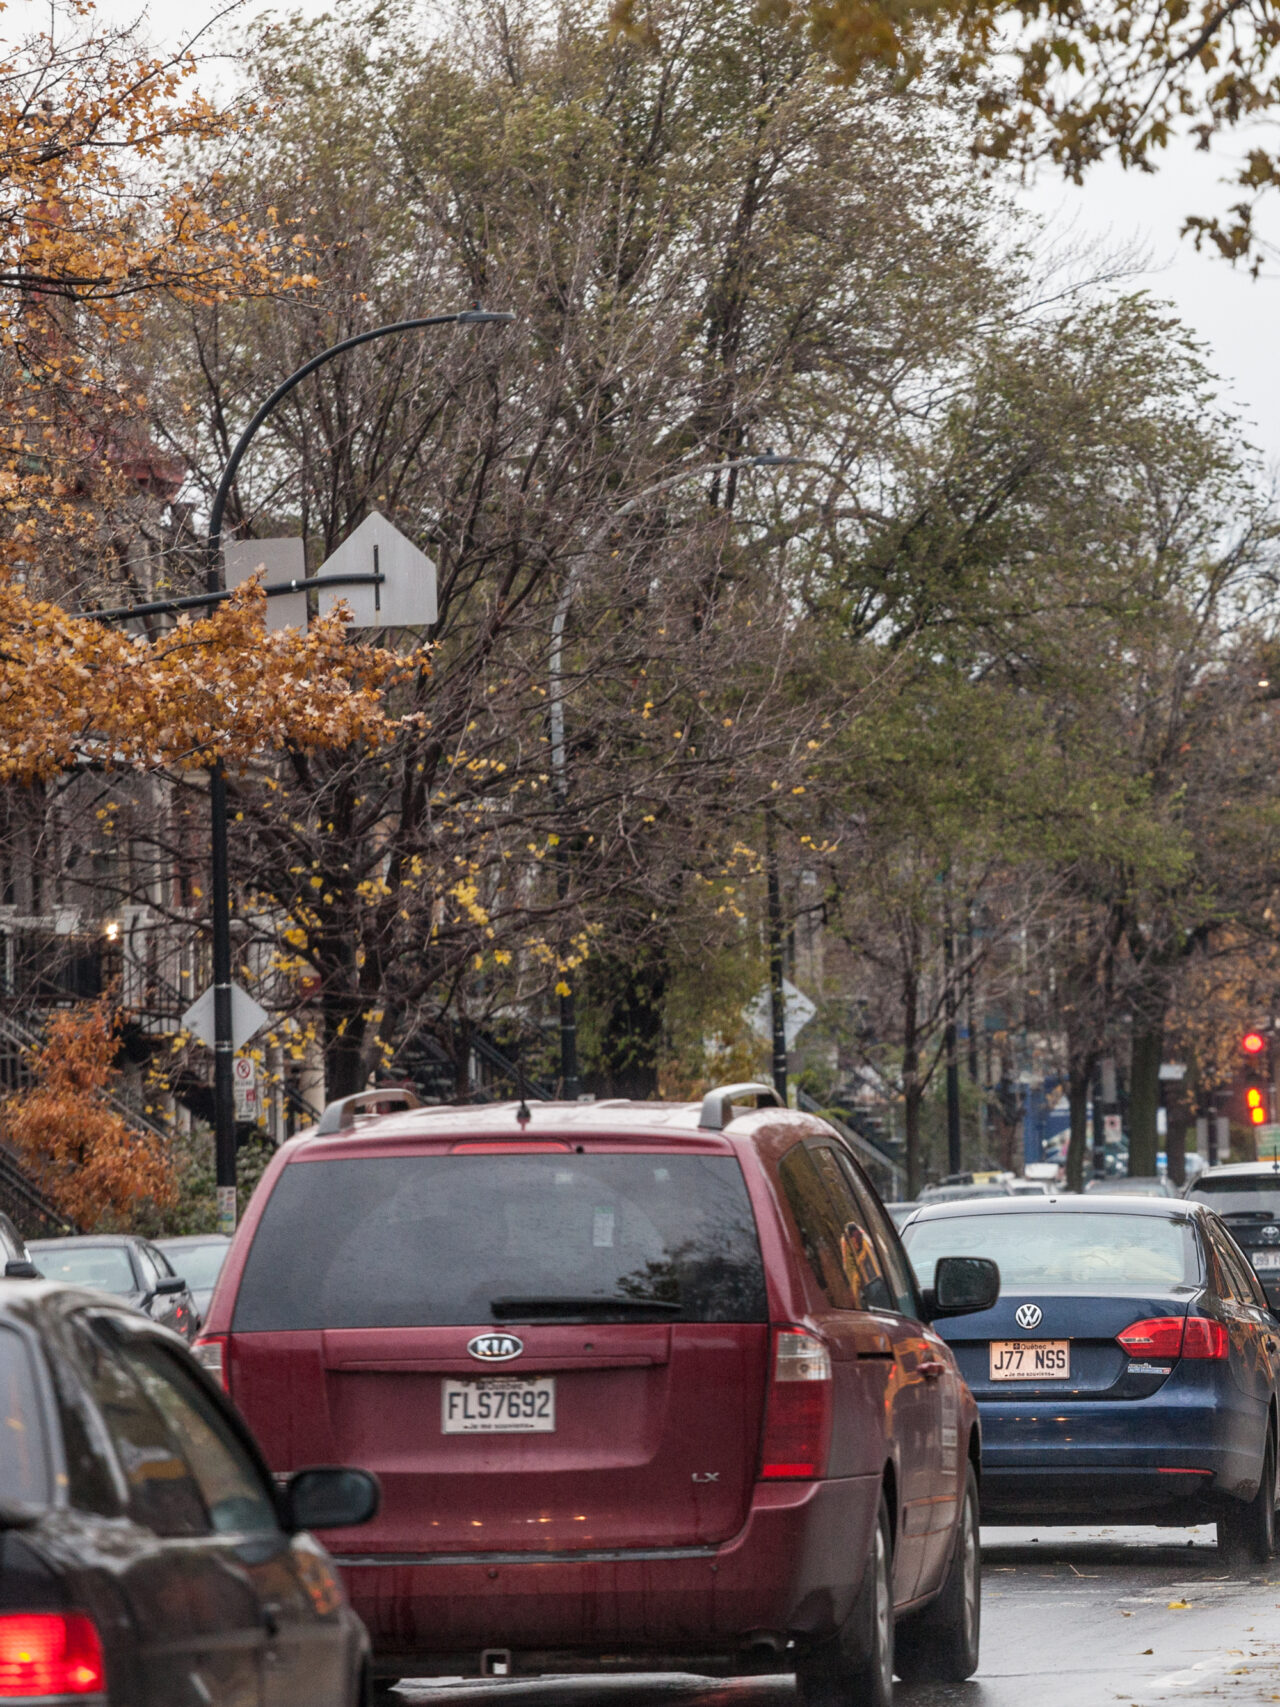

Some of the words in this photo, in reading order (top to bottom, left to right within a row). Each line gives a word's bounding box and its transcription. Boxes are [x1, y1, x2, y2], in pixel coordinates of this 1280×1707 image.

[476, 1339, 515, 1356] KIA
[994, 1350, 1024, 1370] J77
[1035, 1349, 1066, 1369] NSS
[448, 1390, 550, 1420] FLS7692
[691, 1472, 720, 1483] LX
